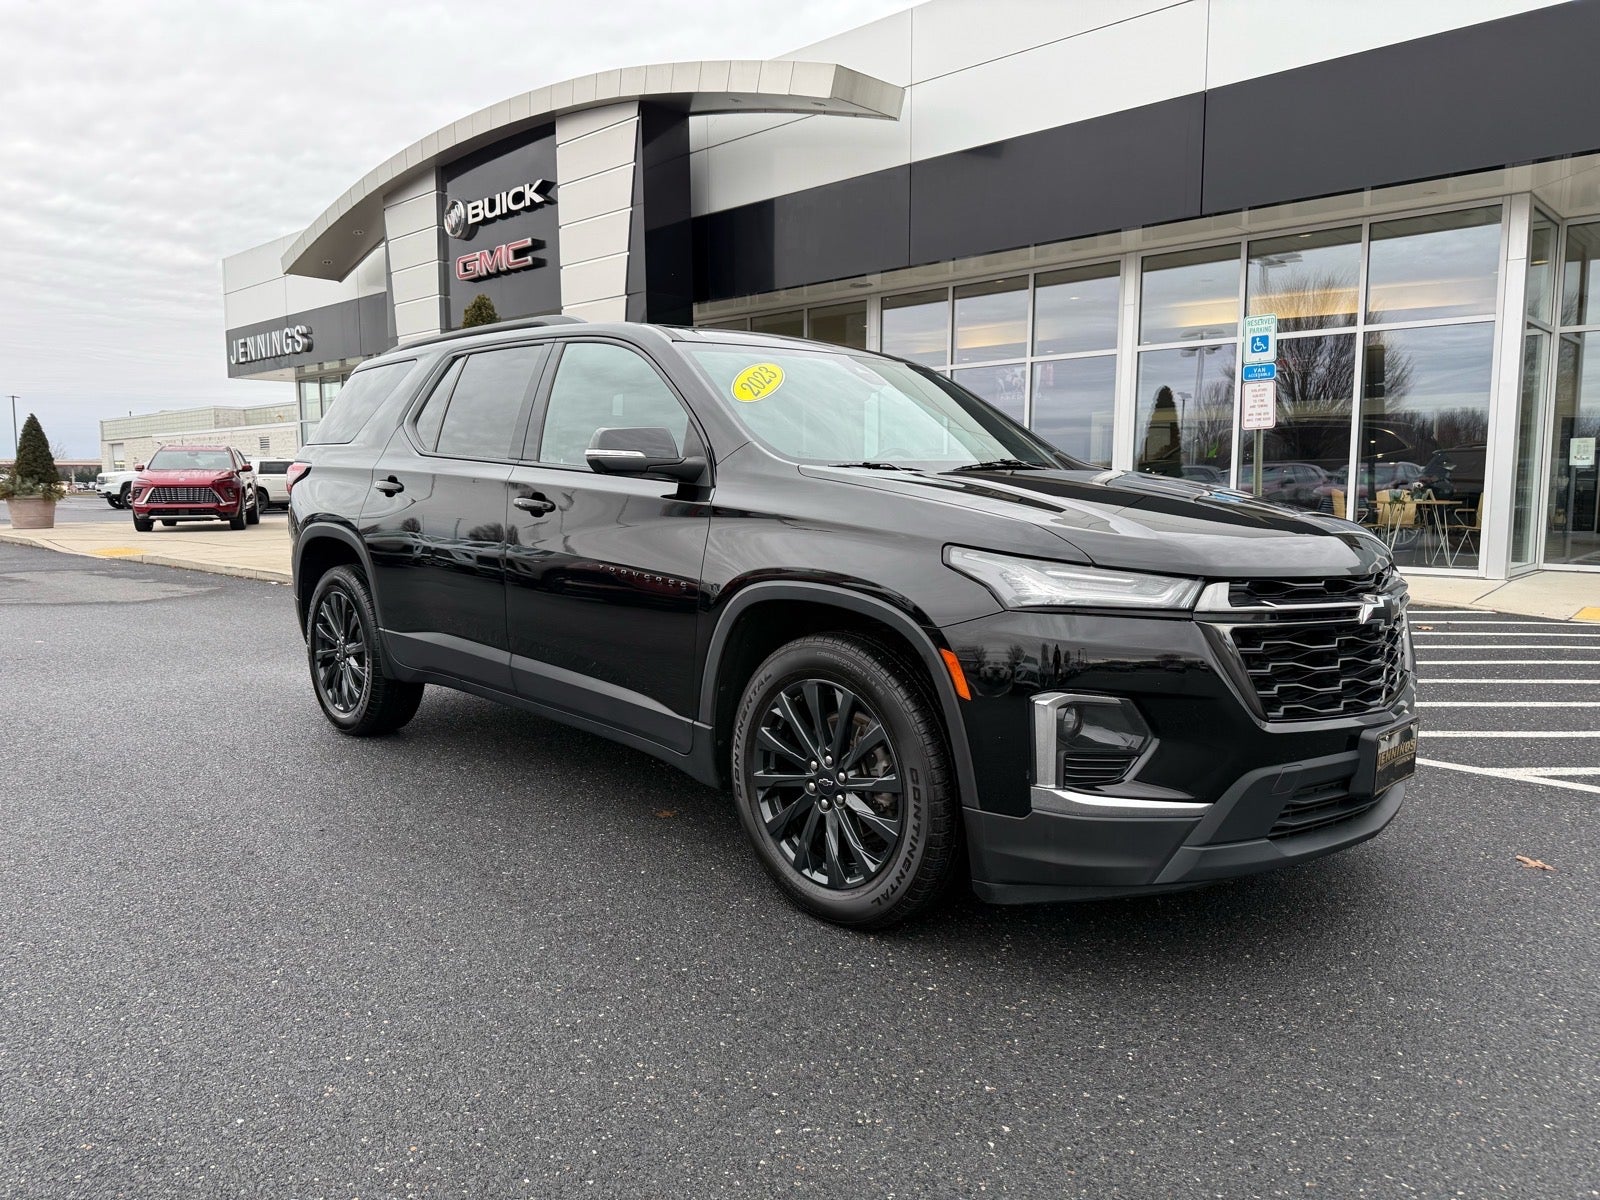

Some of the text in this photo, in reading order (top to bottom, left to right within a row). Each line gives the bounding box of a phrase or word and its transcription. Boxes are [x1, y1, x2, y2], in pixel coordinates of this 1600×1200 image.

[467, 178, 545, 224] BUICK
[456, 237, 533, 281] GMC
[1247, 317, 1275, 327] RESERVED
[1249, 325, 1272, 334] PARKING
[230, 325, 306, 364] JENNINGS
[740, 366, 777, 397] 2023
[732, 673, 773, 800] CONTINENTAL
[871, 767, 923, 907] CONTINENTAL
